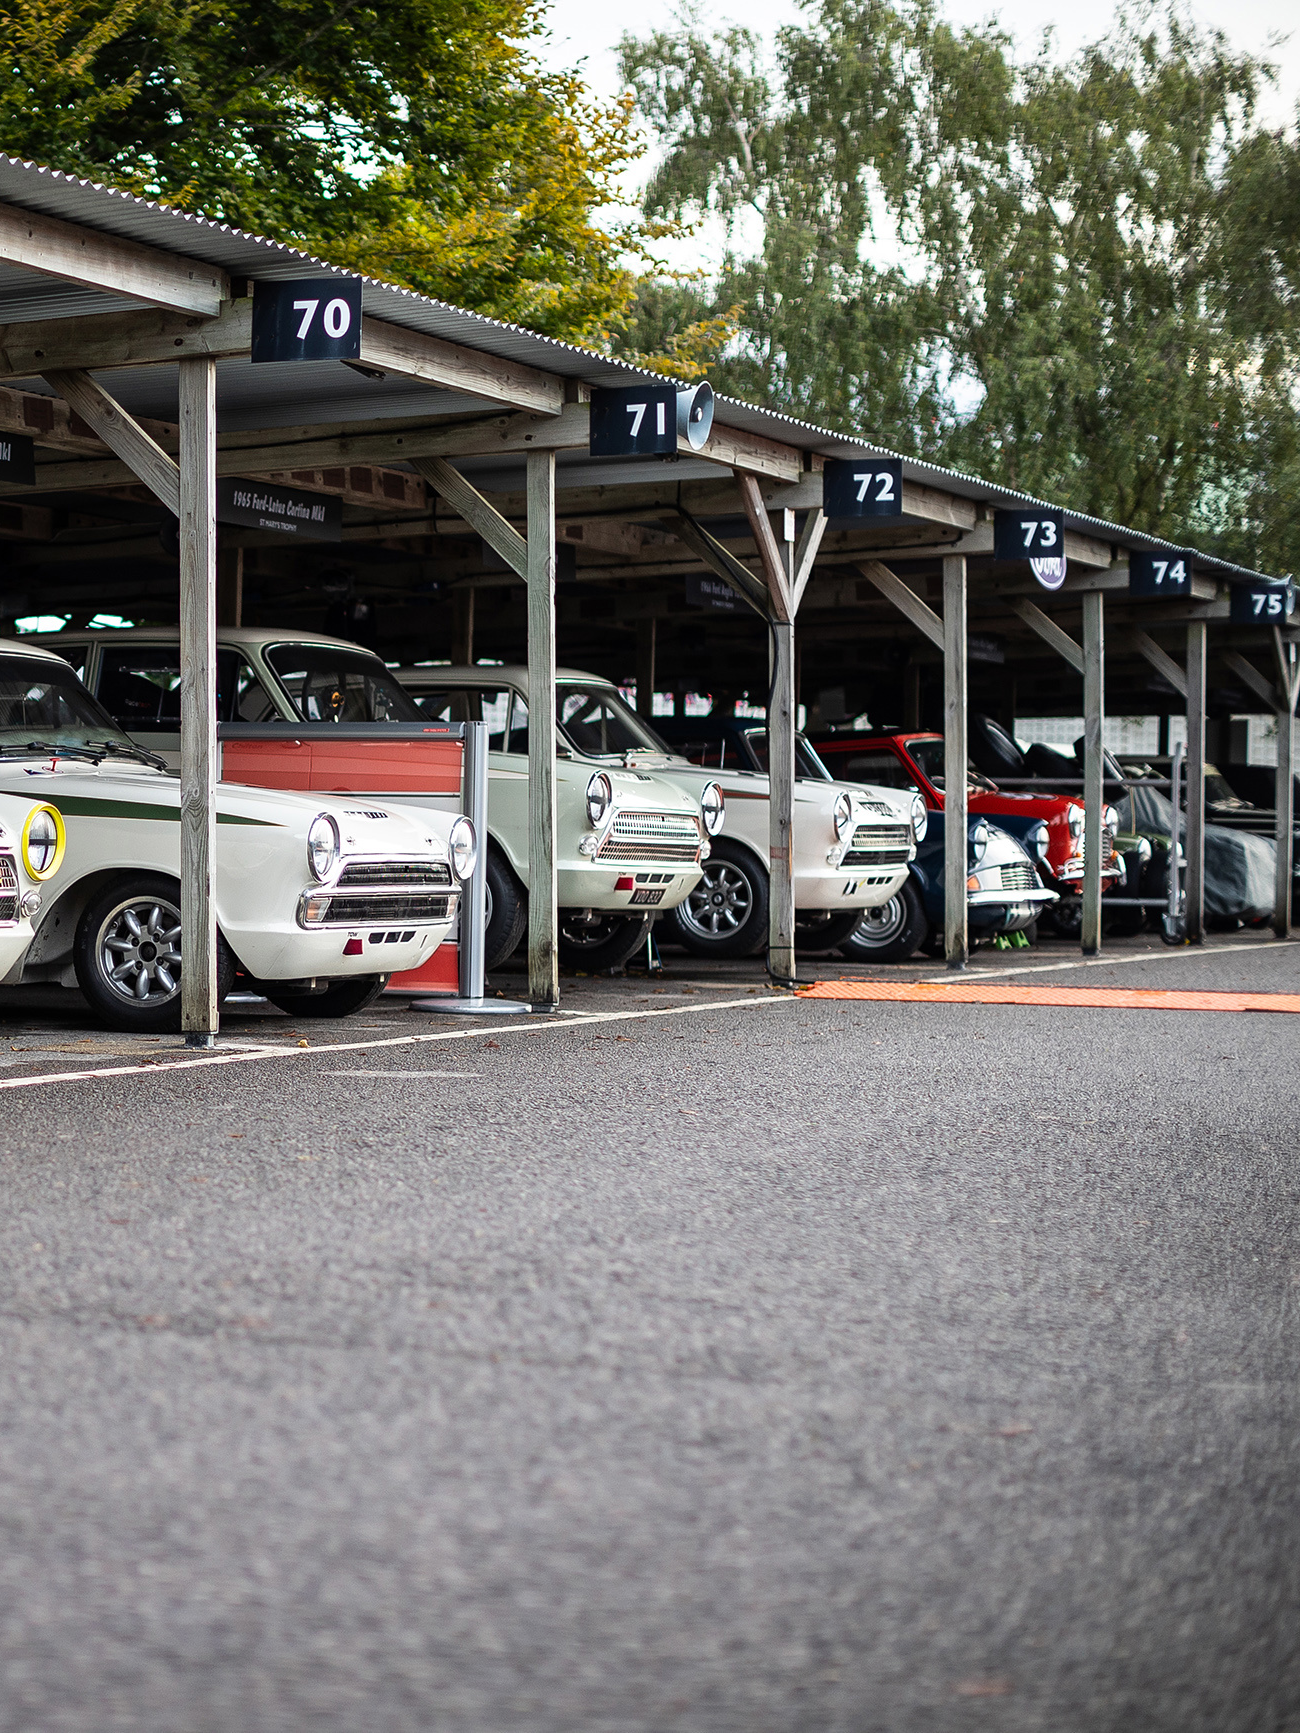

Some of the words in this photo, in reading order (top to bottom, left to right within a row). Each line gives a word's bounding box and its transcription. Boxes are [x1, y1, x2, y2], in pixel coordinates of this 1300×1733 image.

[293, 298, 351, 340] 70
[626, 402, 666, 437] 71
[853, 472, 895, 502] 72
[233, 490, 251, 508] 1965
[252, 493, 286, 516] Ford-Lotus
[286, 500, 310, 520] Cortina
[1020, 521, 1057, 548] 73
[1152, 560, 1187, 585] 74
[1251, 593, 1283, 615] 75
